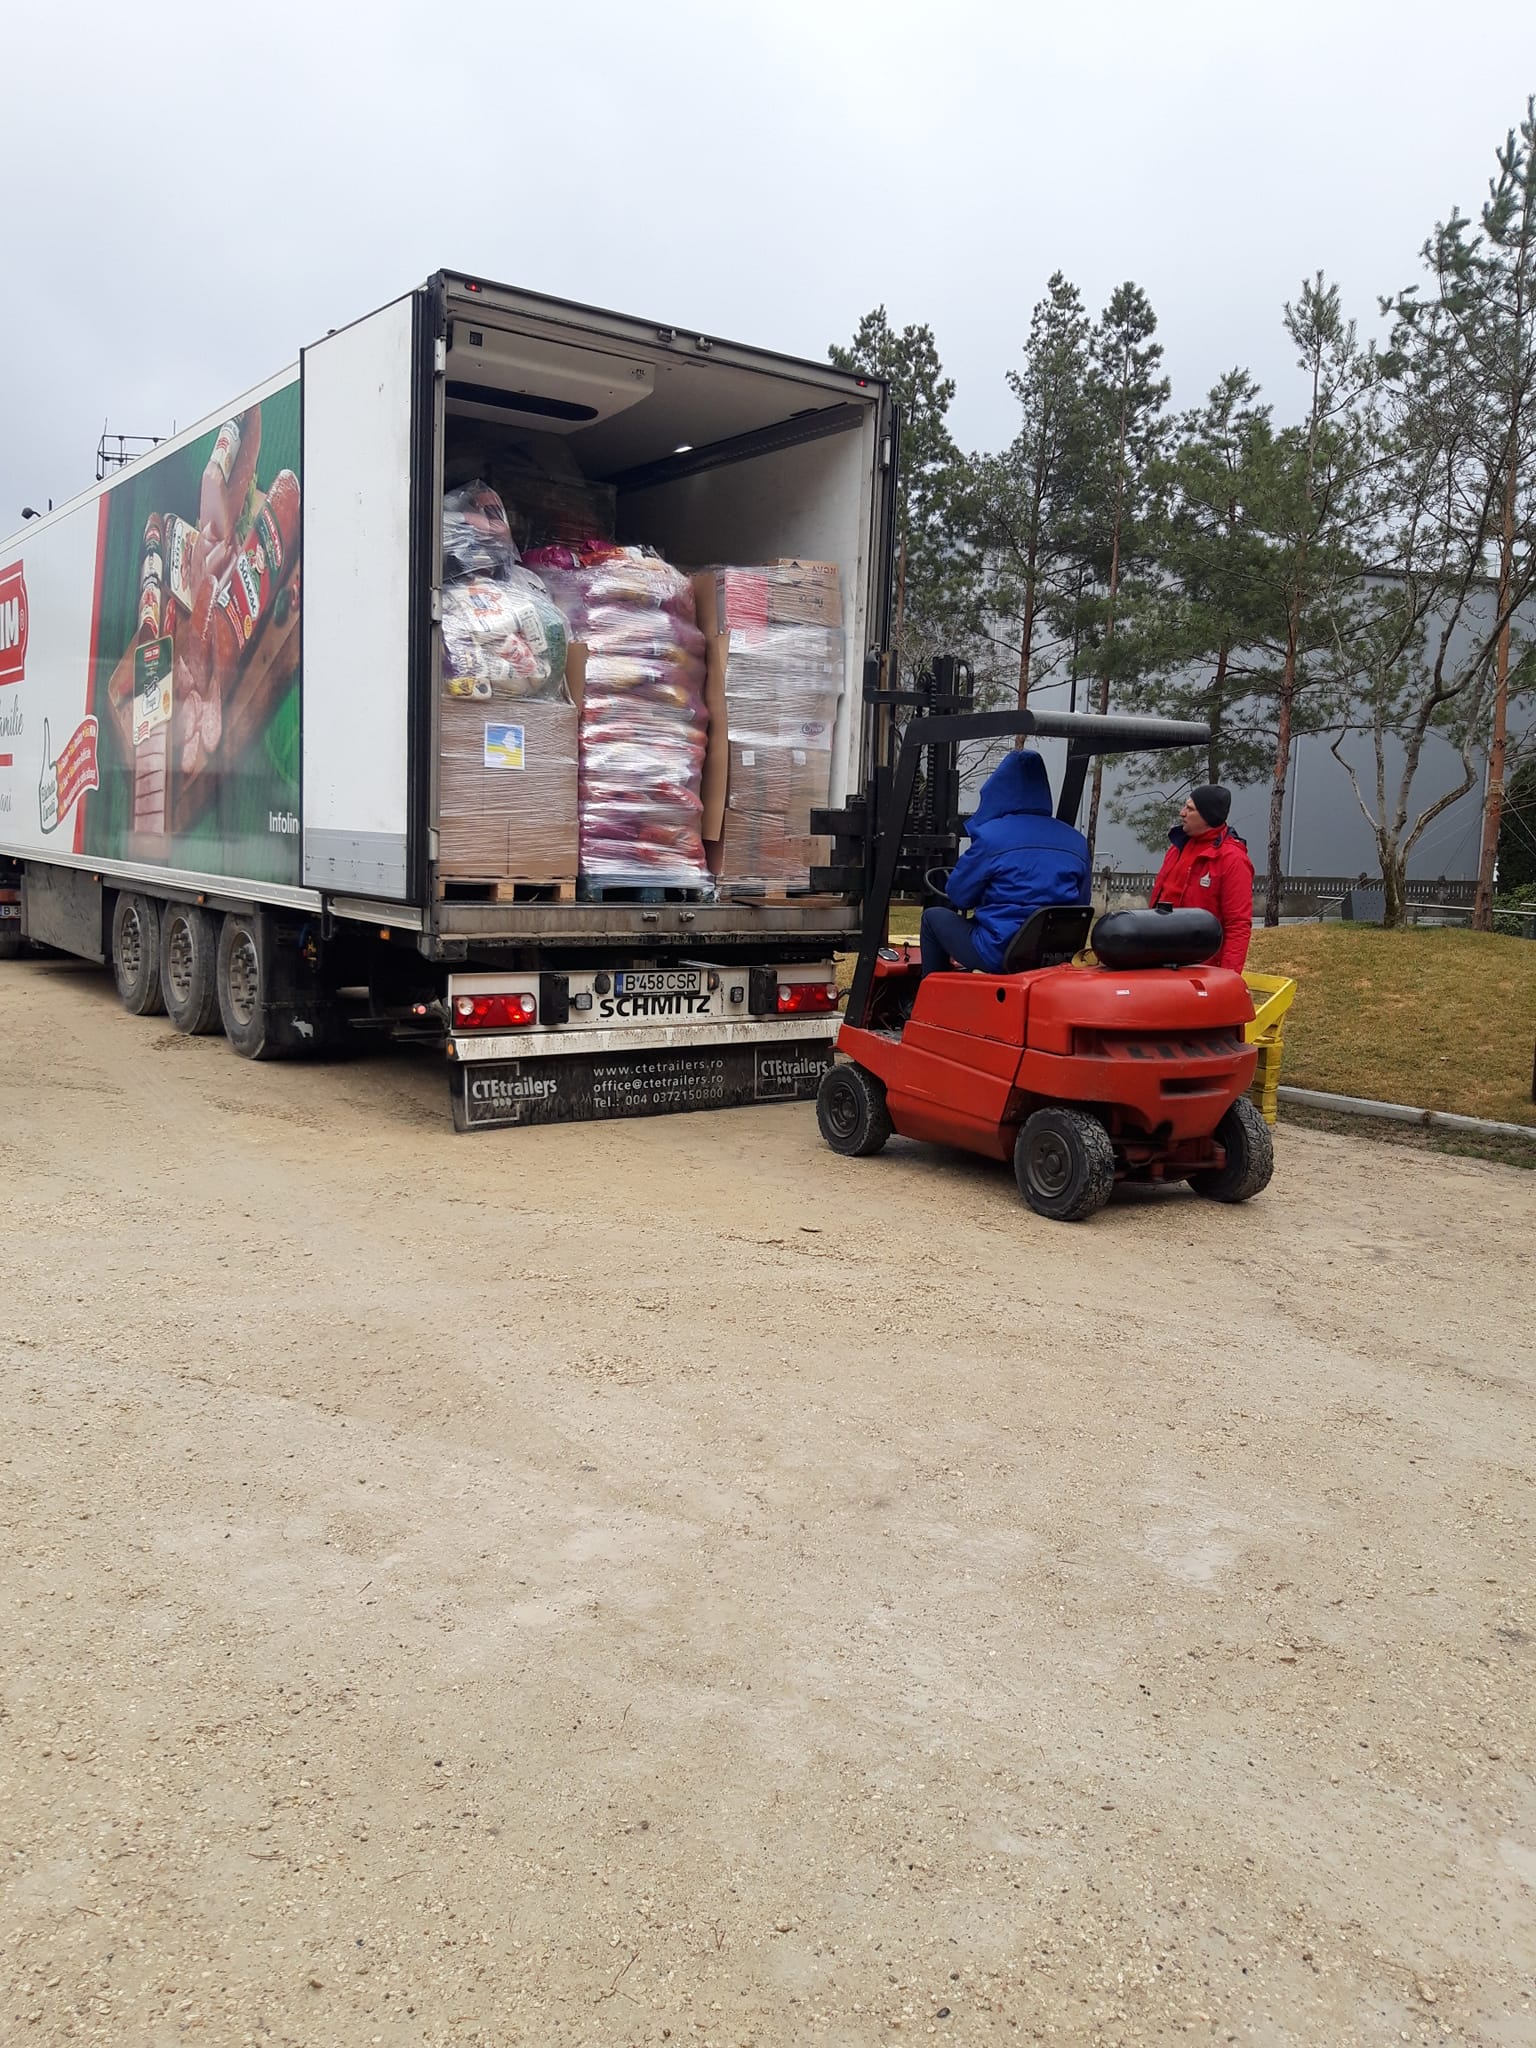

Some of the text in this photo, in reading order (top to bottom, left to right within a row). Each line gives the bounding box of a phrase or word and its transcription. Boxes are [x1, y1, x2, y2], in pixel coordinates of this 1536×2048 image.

[625, 975, 636, 991] B
[639, 974, 664, 991] 458
[666, 973, 697, 990] CSR
[599, 995, 711, 1018] SCHMITZ
[593, 1060, 724, 1077] www.ctetrailers.ro
[760, 1057, 828, 1078] CTEtrailers
[472, 1076, 558, 1099] CTEtrailers
[593, 1074, 724, 1093] office@ctetrailers.ro
[593, 1088, 724, 1109] Tel.: 004 0372150800
